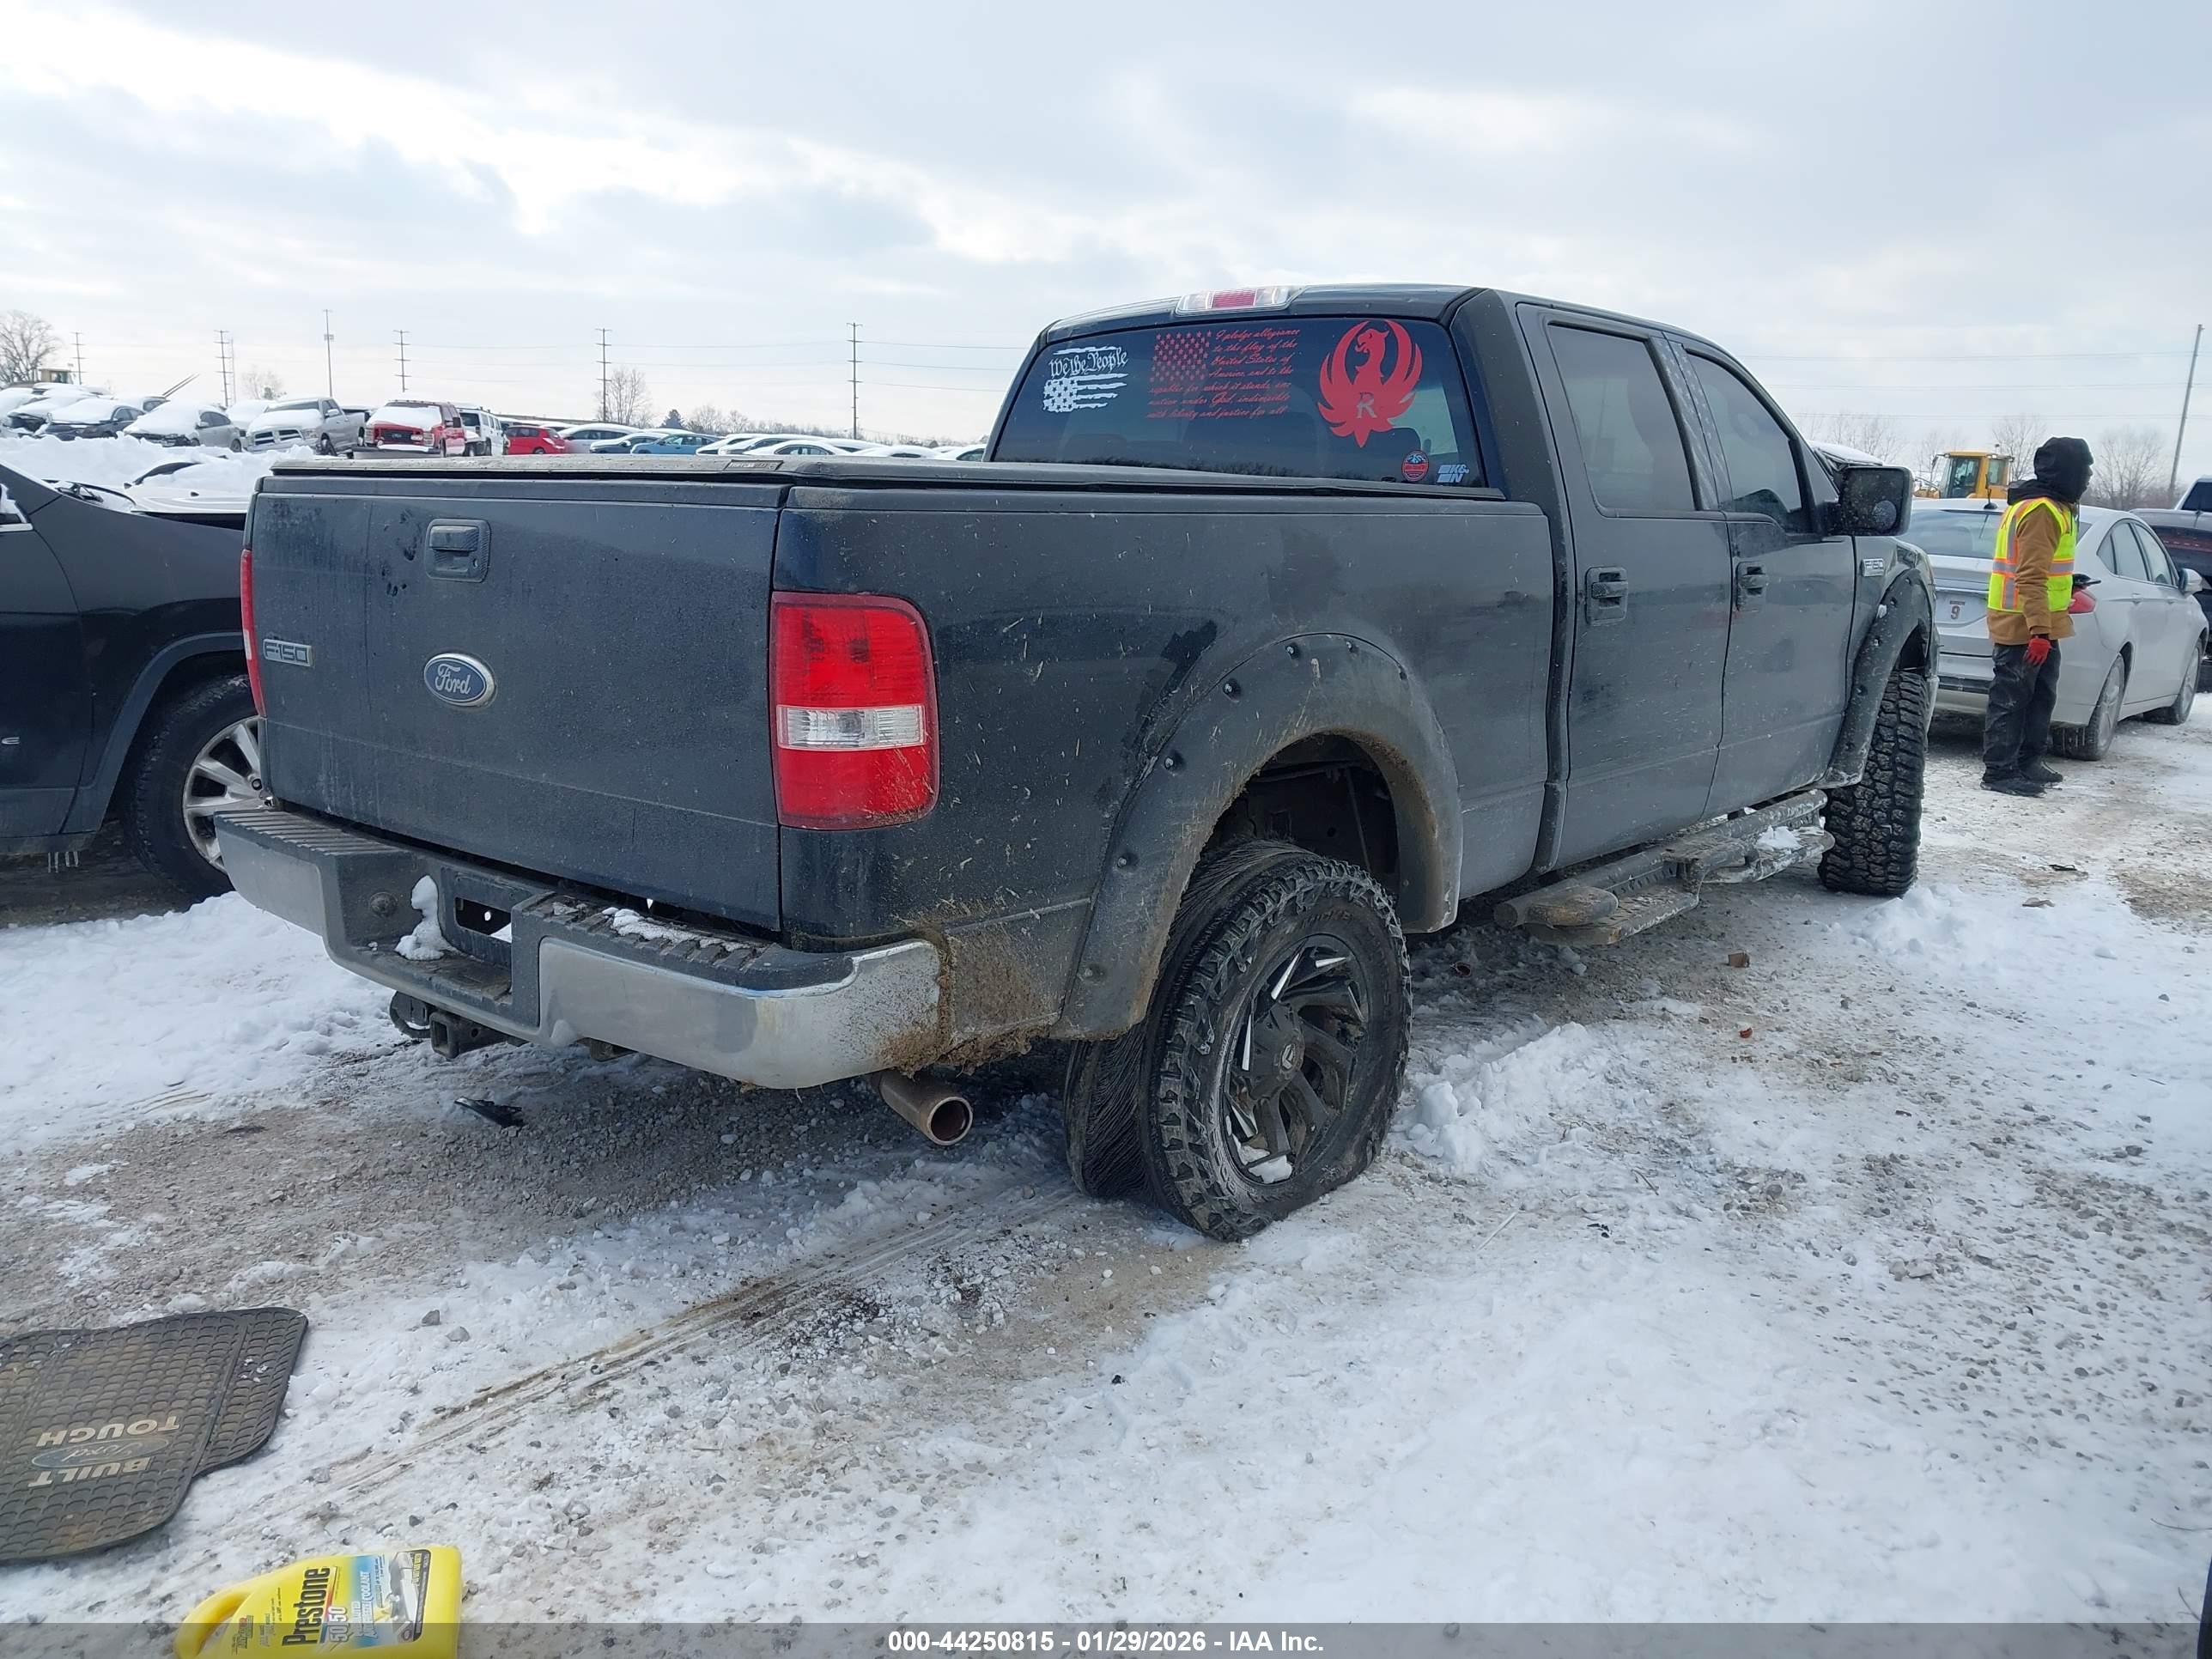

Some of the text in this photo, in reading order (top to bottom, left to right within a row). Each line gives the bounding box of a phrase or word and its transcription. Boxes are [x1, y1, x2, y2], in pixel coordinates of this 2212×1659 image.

[1048, 358, 1070, 379] We
[1084, 347, 1129, 376] People
[1356, 392, 1377, 419] R
[265, 641, 308, 663] F-150
[434, 663, 471, 695] Ford
[36, 1416, 179, 1447] TOUGH
[61, 1442, 143, 1462] Ford
[27, 1456, 151, 1487] BUILT
[282, 1567, 331, 1646] Prestone
